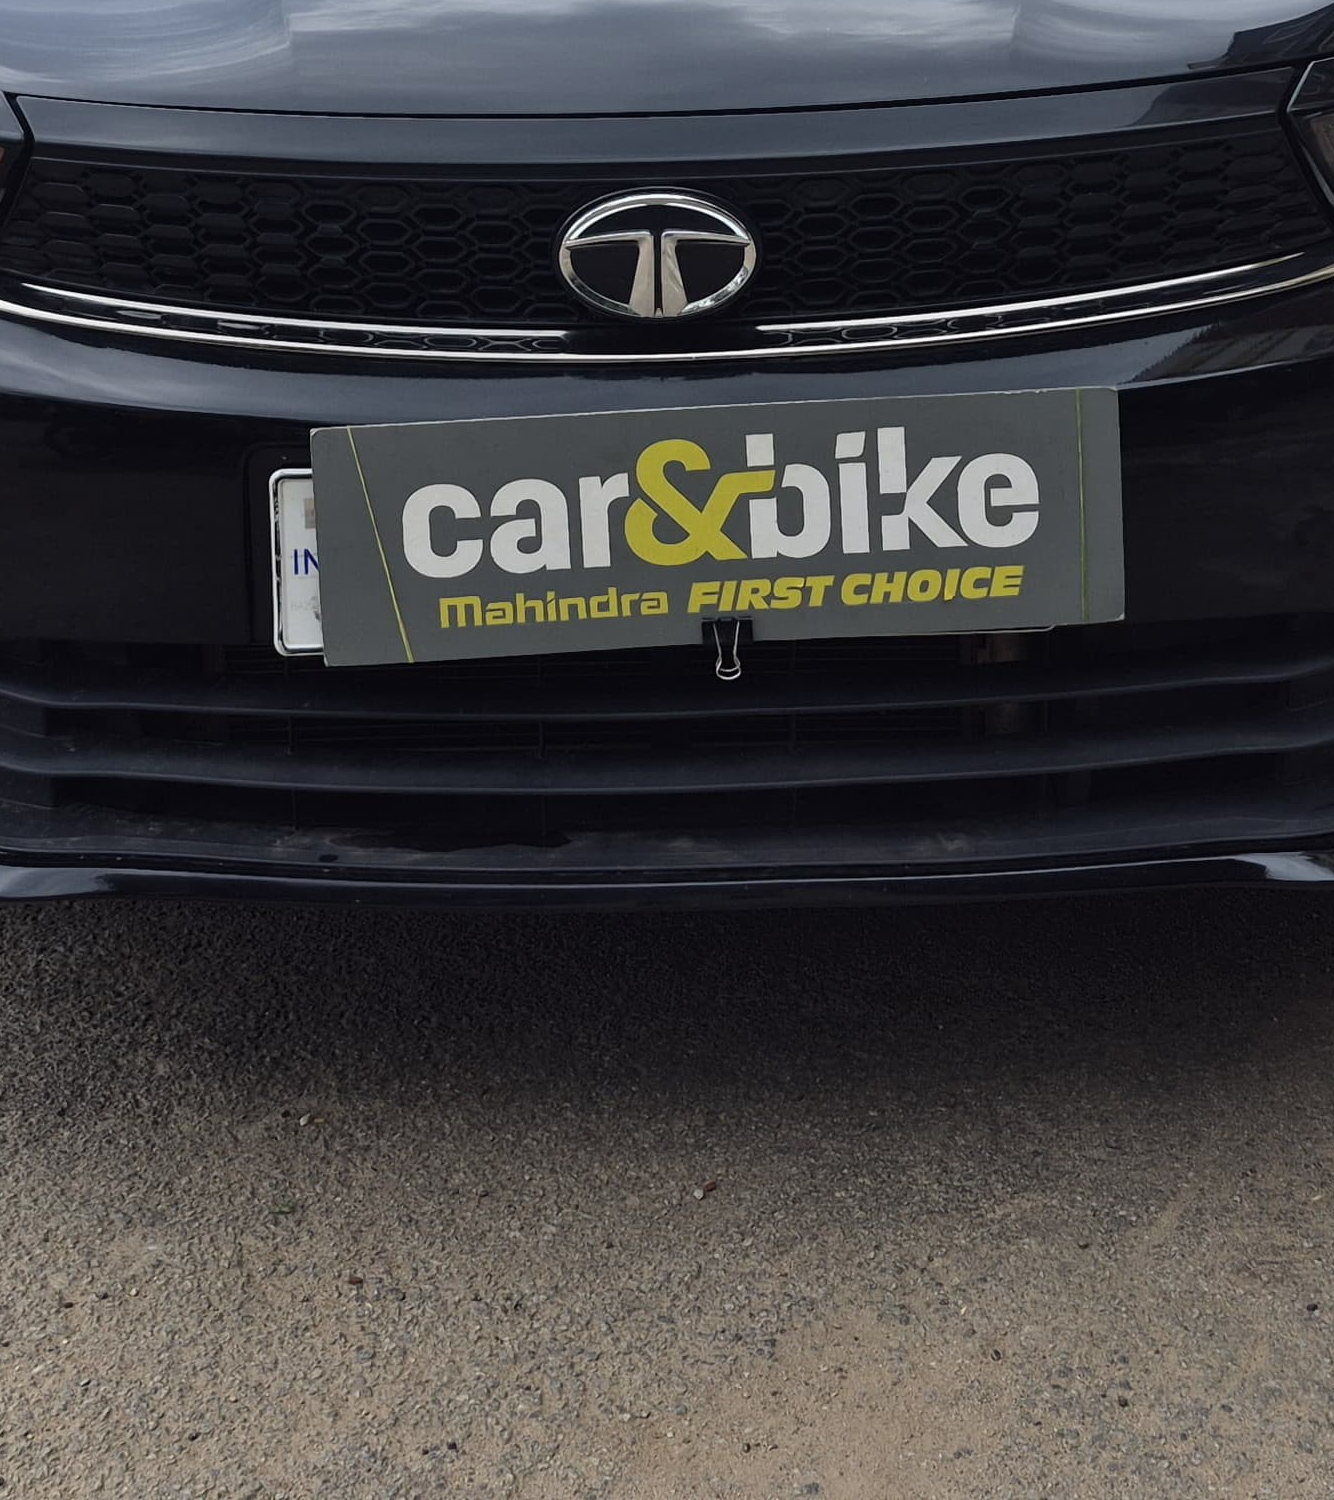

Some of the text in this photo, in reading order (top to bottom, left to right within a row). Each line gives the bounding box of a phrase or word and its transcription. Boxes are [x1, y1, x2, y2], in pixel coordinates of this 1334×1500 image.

[402, 426, 1041, 579] car&bike
[439, 564, 1025, 630] Mahindra FIRST CHOICE
